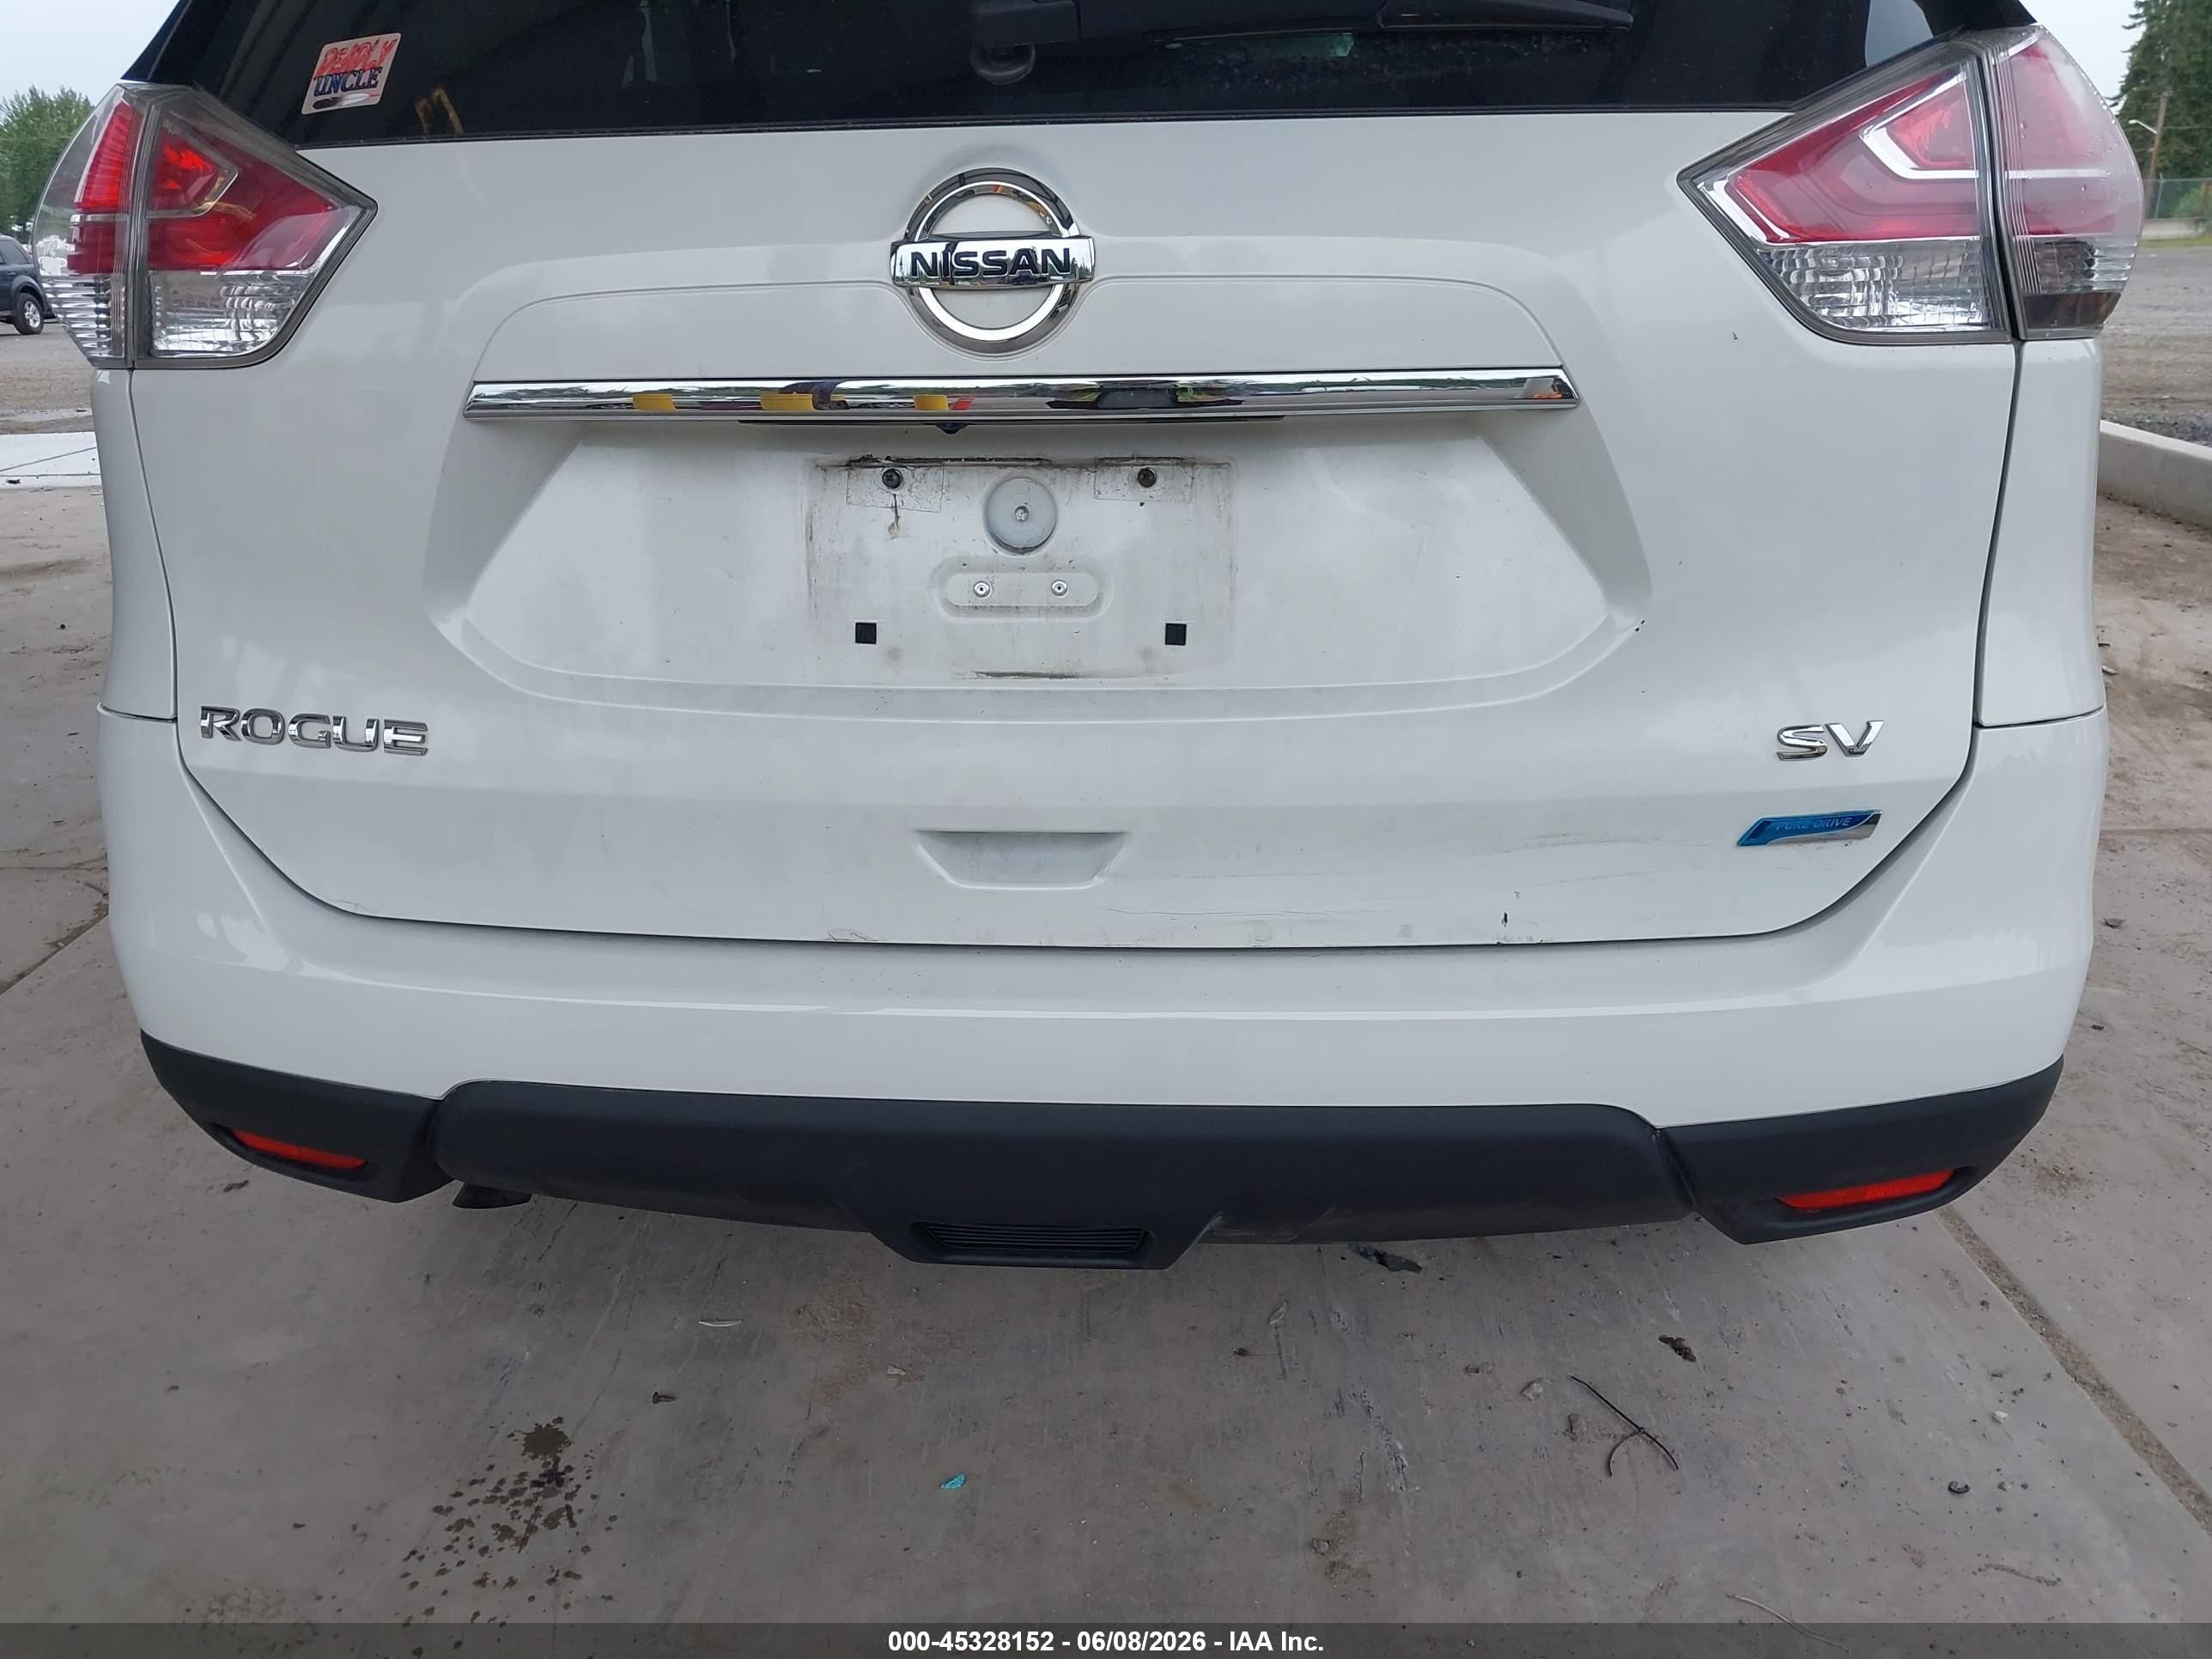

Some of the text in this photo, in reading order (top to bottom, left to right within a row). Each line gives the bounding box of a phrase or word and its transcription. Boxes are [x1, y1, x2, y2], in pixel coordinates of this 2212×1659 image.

[313, 66, 383, 96] UNCLE
[910, 247, 1071, 277] NISSAN
[200, 705, 428, 757] ROGUE
[1777, 720, 1885, 762] SV
[1813, 817, 1852, 829] DRIVE
